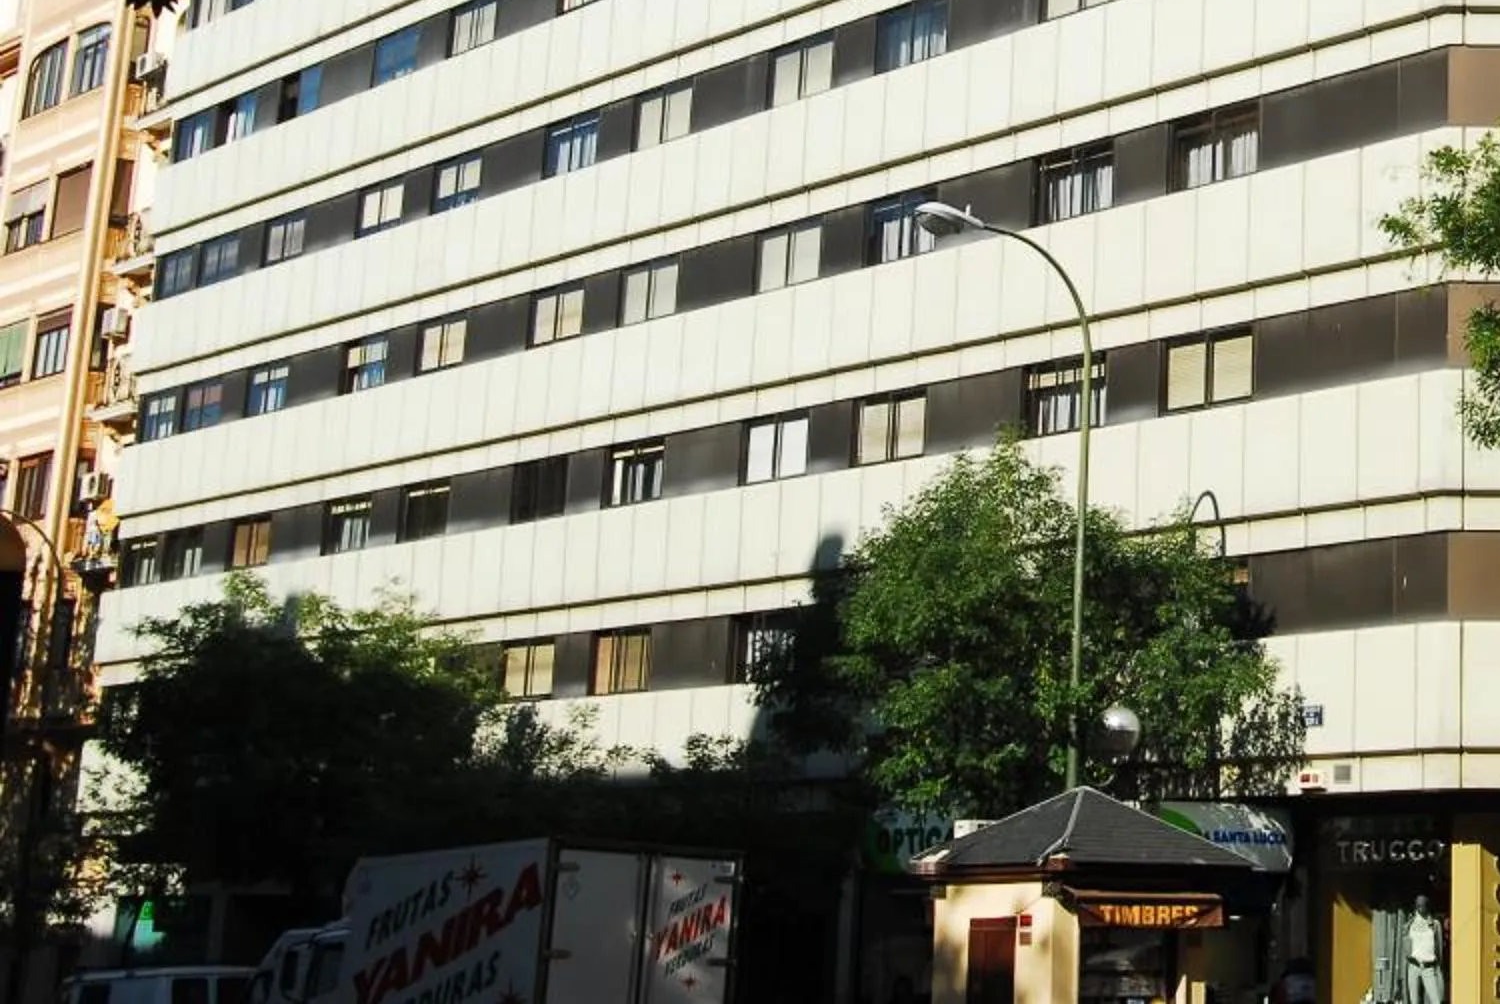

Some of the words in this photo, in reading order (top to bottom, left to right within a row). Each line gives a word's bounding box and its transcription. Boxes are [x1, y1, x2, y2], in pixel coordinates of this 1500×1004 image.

[1336, 839, 1444, 864] TRUCCO
[354, 861, 544, 1004] YANIRA
[364, 870, 455, 951] FRUTAS
[656, 895, 727, 962] YANIRA
[1099, 904, 1199, 927] TIMBRES
